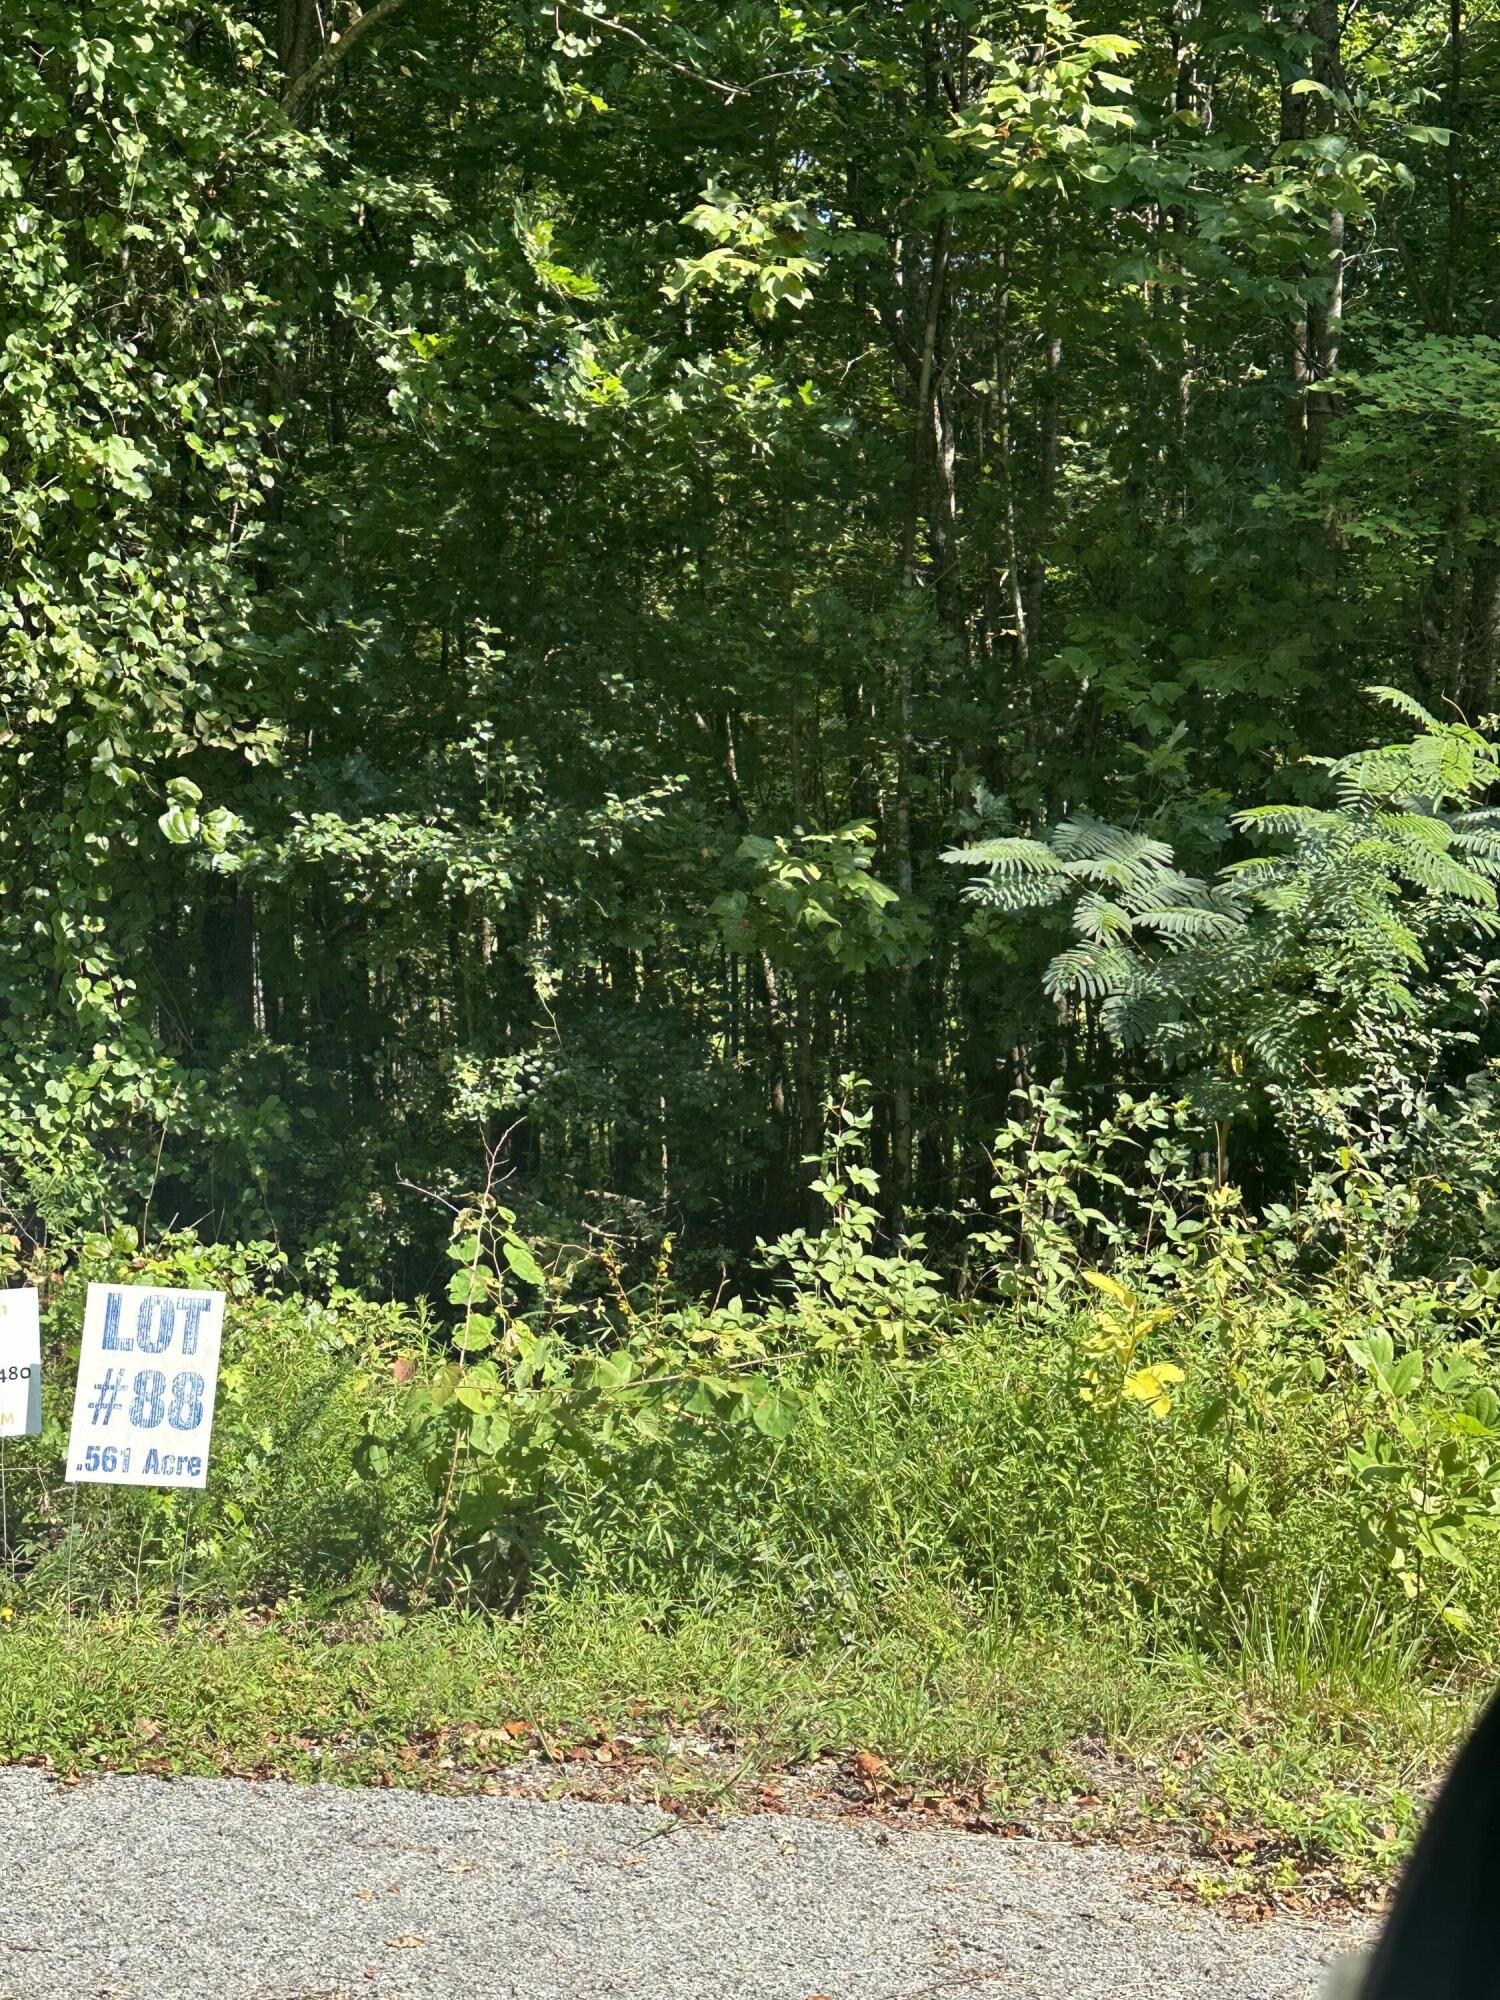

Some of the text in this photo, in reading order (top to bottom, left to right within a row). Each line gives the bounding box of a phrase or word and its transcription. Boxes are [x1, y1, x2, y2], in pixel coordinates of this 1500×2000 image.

[102, 1292, 211, 1355] LOT
[88, 1368, 205, 1430] #88
[76, 1445, 201, 1477] .561 Acre
